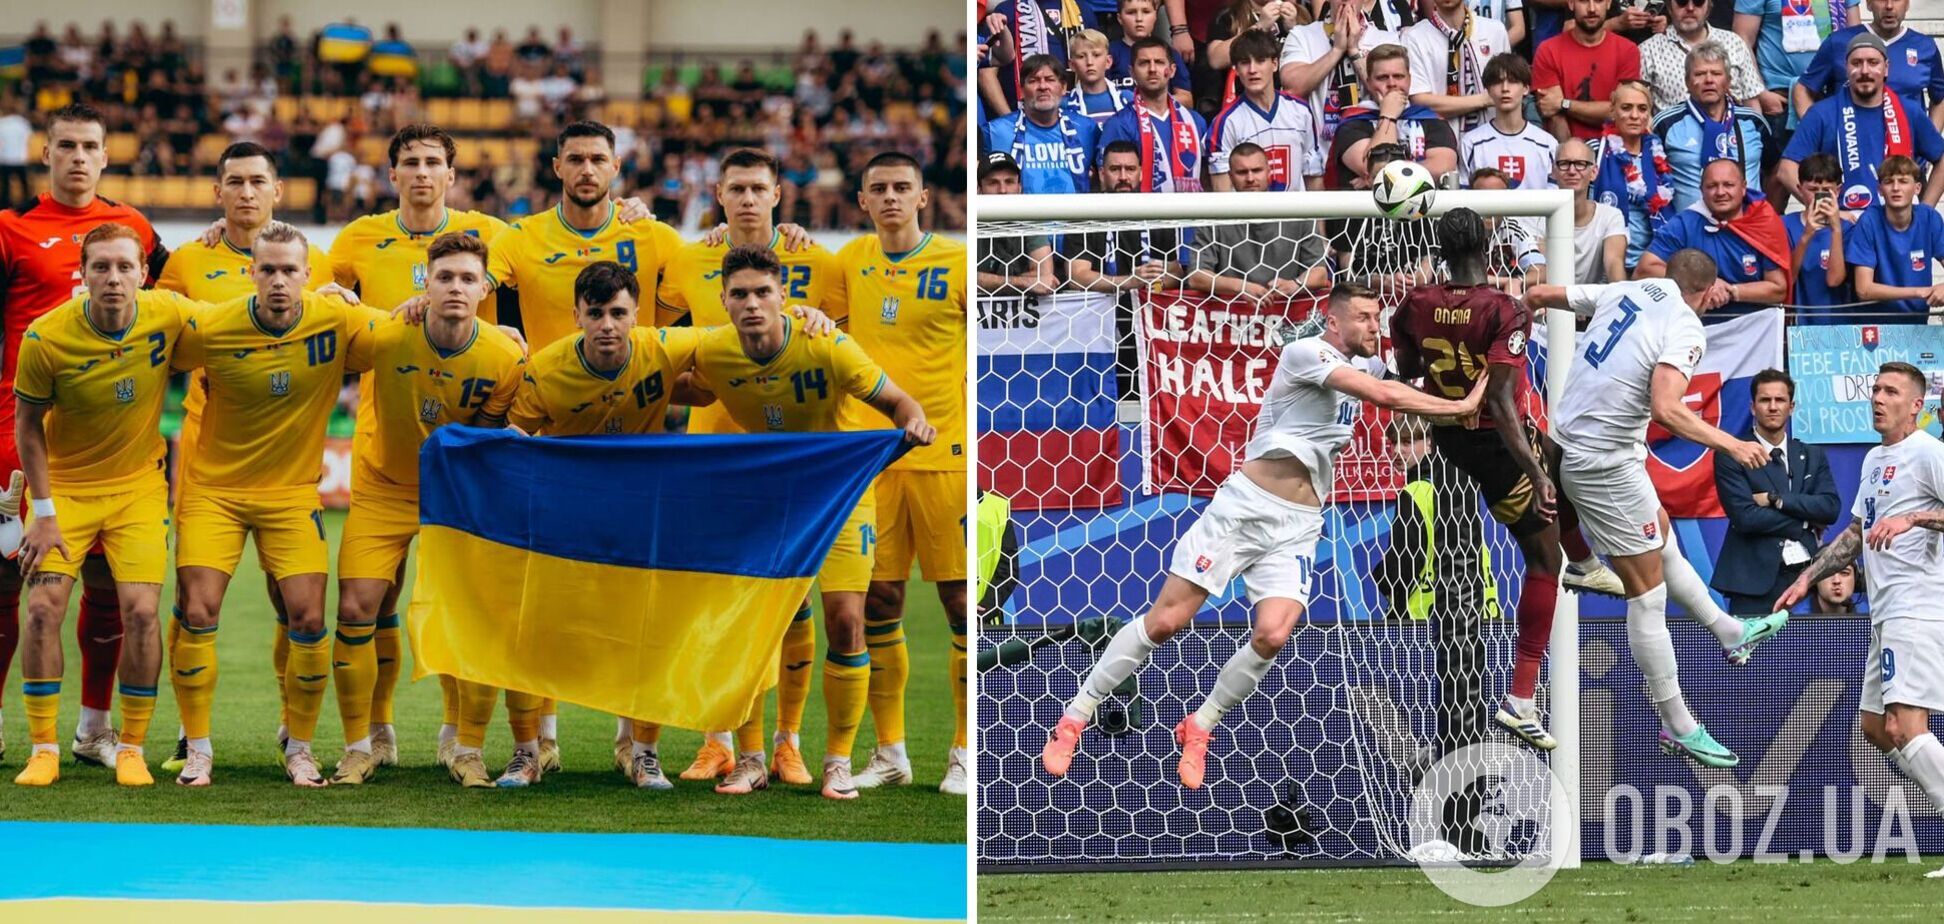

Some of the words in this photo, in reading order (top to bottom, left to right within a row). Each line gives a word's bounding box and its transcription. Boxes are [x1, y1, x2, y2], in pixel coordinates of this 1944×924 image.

[1883, 92, 1902, 144] BELGIU
[1842, 106, 1860, 172] SLOVAKIA
[616, 240, 638, 273] 9
[916, 267, 949, 301] 16
[1143, 302, 1284, 348] LEATHER
[1434, 308, 1471, 324] ONANA
[1584, 295, 1642, 370] 3
[148, 331, 166, 367] 2
[304, 329, 337, 367] 10
[1790, 352, 1833, 375] TEBE
[790, 367, 828, 404] 14
[1158, 352, 1267, 405] HALE
[1422, 337, 1488, 398] 24
[459, 376, 496, 409] 15
[632, 370, 664, 410] 19
[1797, 408, 1812, 434] SI
[1820, 405, 1874, 435] PROSI
[1334, 465, 1361, 478] ALK
[1364, 465, 1406, 478] ALON
